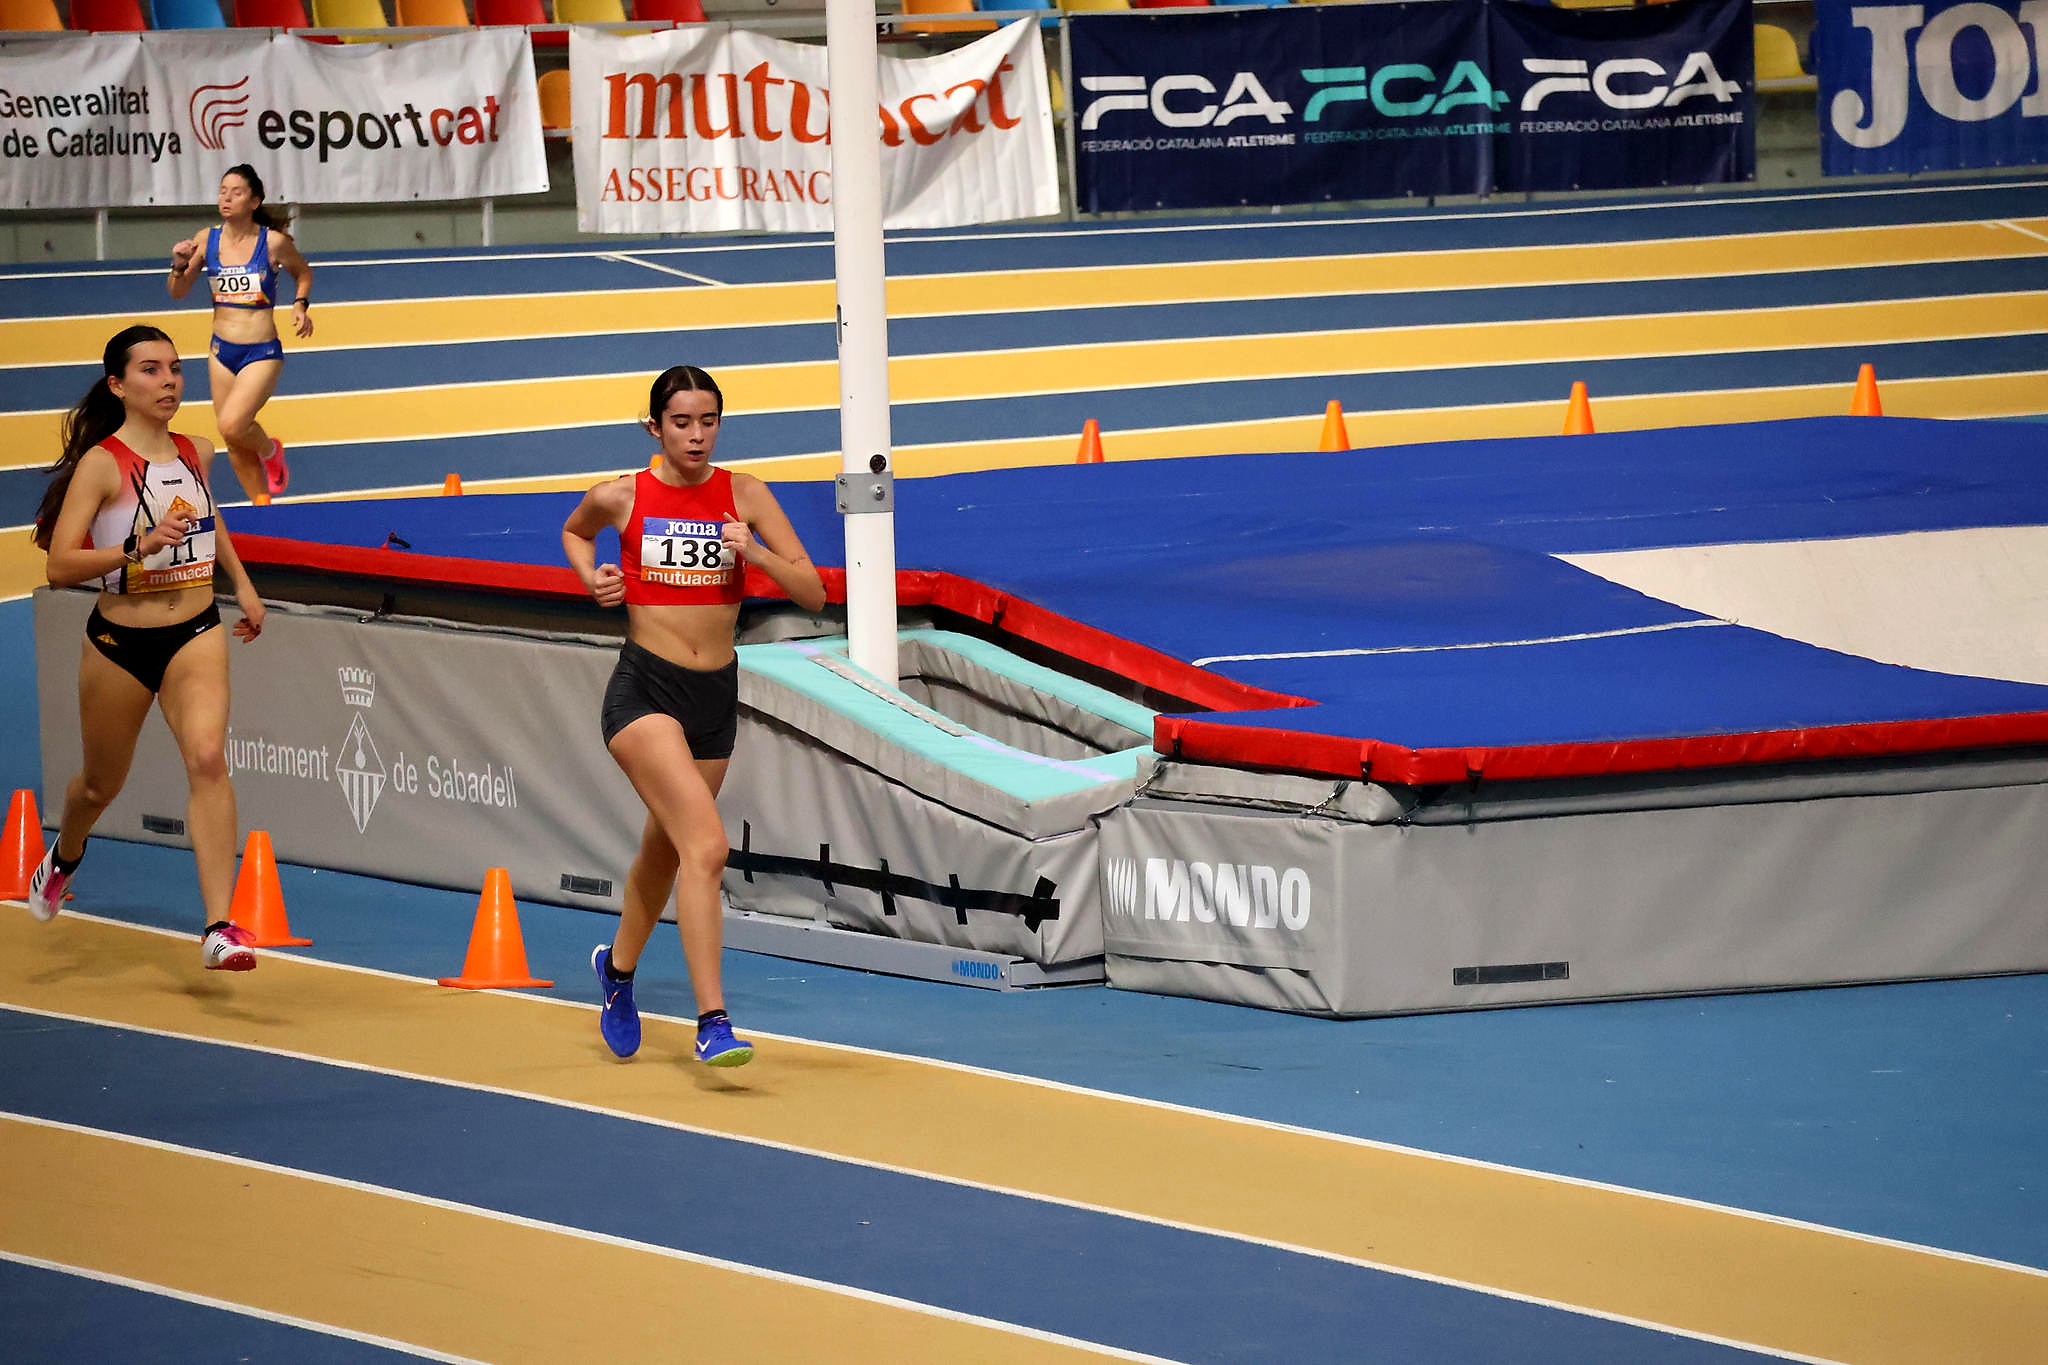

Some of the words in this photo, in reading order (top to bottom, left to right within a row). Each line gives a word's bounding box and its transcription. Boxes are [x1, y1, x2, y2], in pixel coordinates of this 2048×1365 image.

[1301, 60, 1510, 122] FCA
[1516, 51, 1742, 111] FCA
[1831, 1, 2048, 149] JO
[0, 85, 149, 118] Generalitat
[1080, 72, 1294, 130] FCA
[257, 95, 500, 163] esportcat
[1519, 119, 1599, 133] FEDERACIÓ
[1601, 117, 1671, 131] CATALANA
[1674, 111, 1744, 127] ATLETISME
[3, 129, 39, 158] de
[47, 126, 181, 163] Catalunya
[1156, 138, 1224, 150] CATALANA
[1226, 134, 1296, 147] ATLETISME
[601, 166, 832, 205] ASSEGURANC
[216, 276, 251, 293] 209
[169, 537, 198, 567] 11
[660, 539, 722, 569] 138
[393, 751, 418, 794] de
[427, 755, 518, 809] Sabadell
[1144, 857, 1311, 931] MONDO
[959, 960, 999, 980] MONDO
